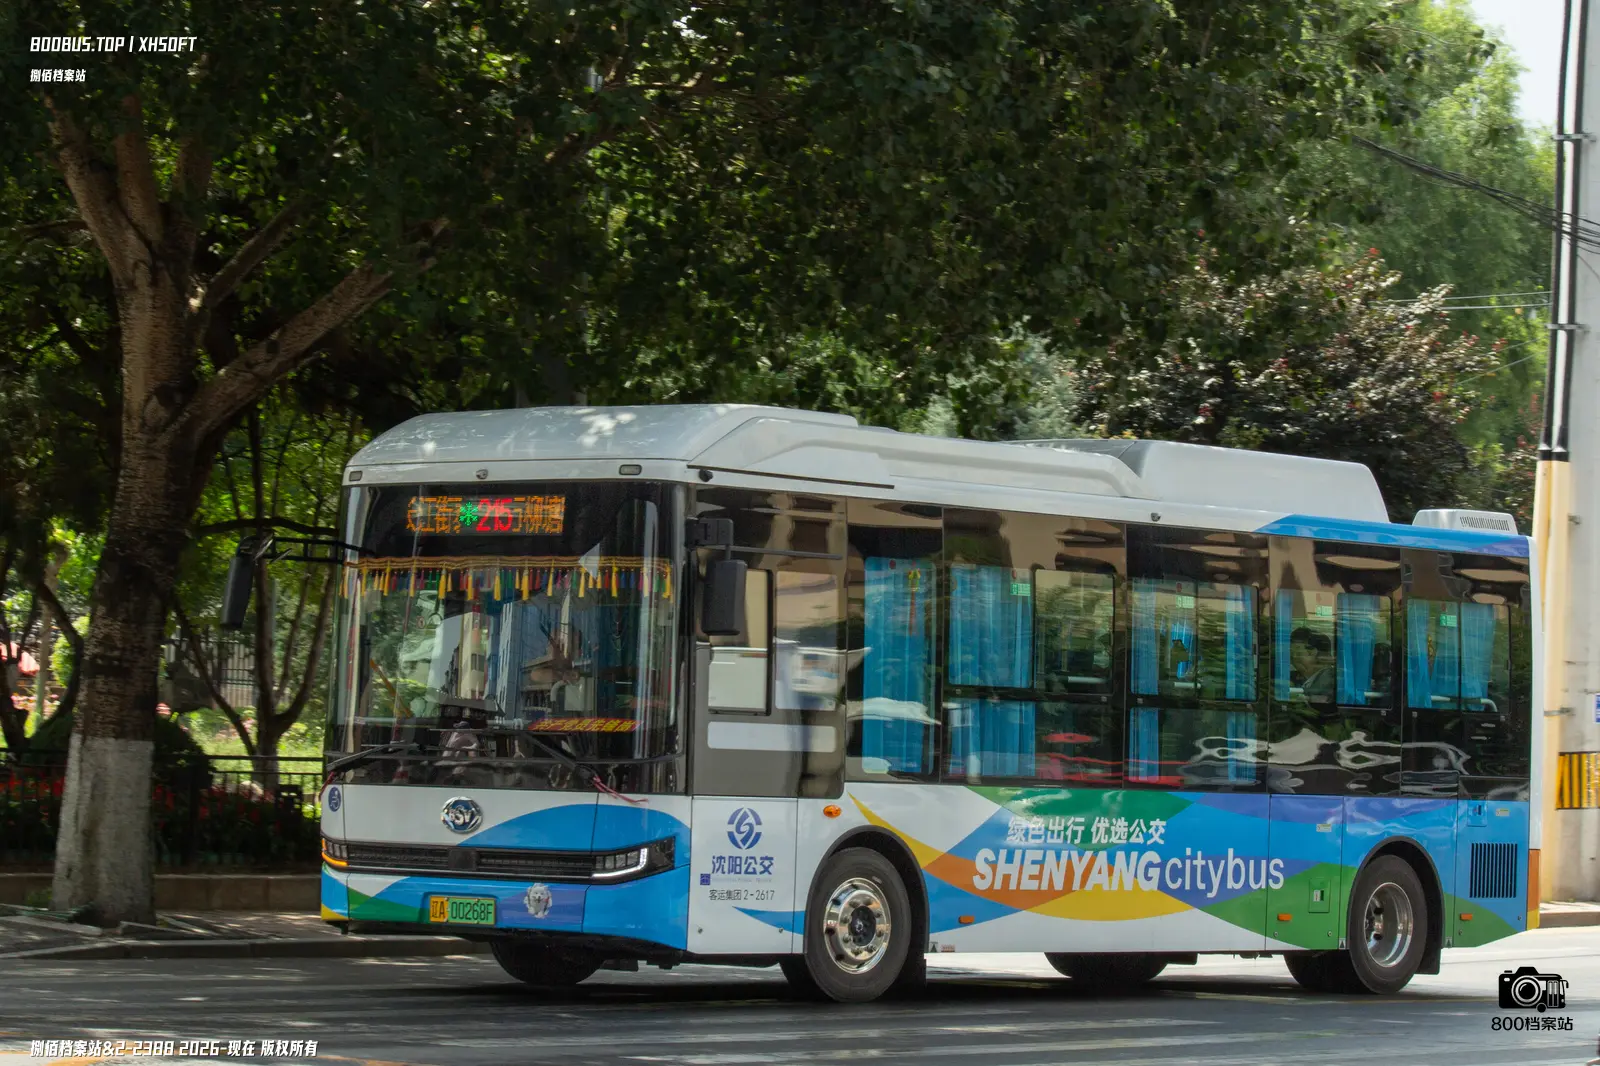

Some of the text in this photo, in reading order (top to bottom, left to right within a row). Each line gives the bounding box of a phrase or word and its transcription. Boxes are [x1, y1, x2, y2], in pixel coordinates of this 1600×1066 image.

[476, 498, 513, 532] 215
[1007, 816, 1167, 845] 绿色出行 优选公交
[711, 855, 774, 875] 沈阳公交
[973, 848, 1285, 898] SHENYANG citybus
